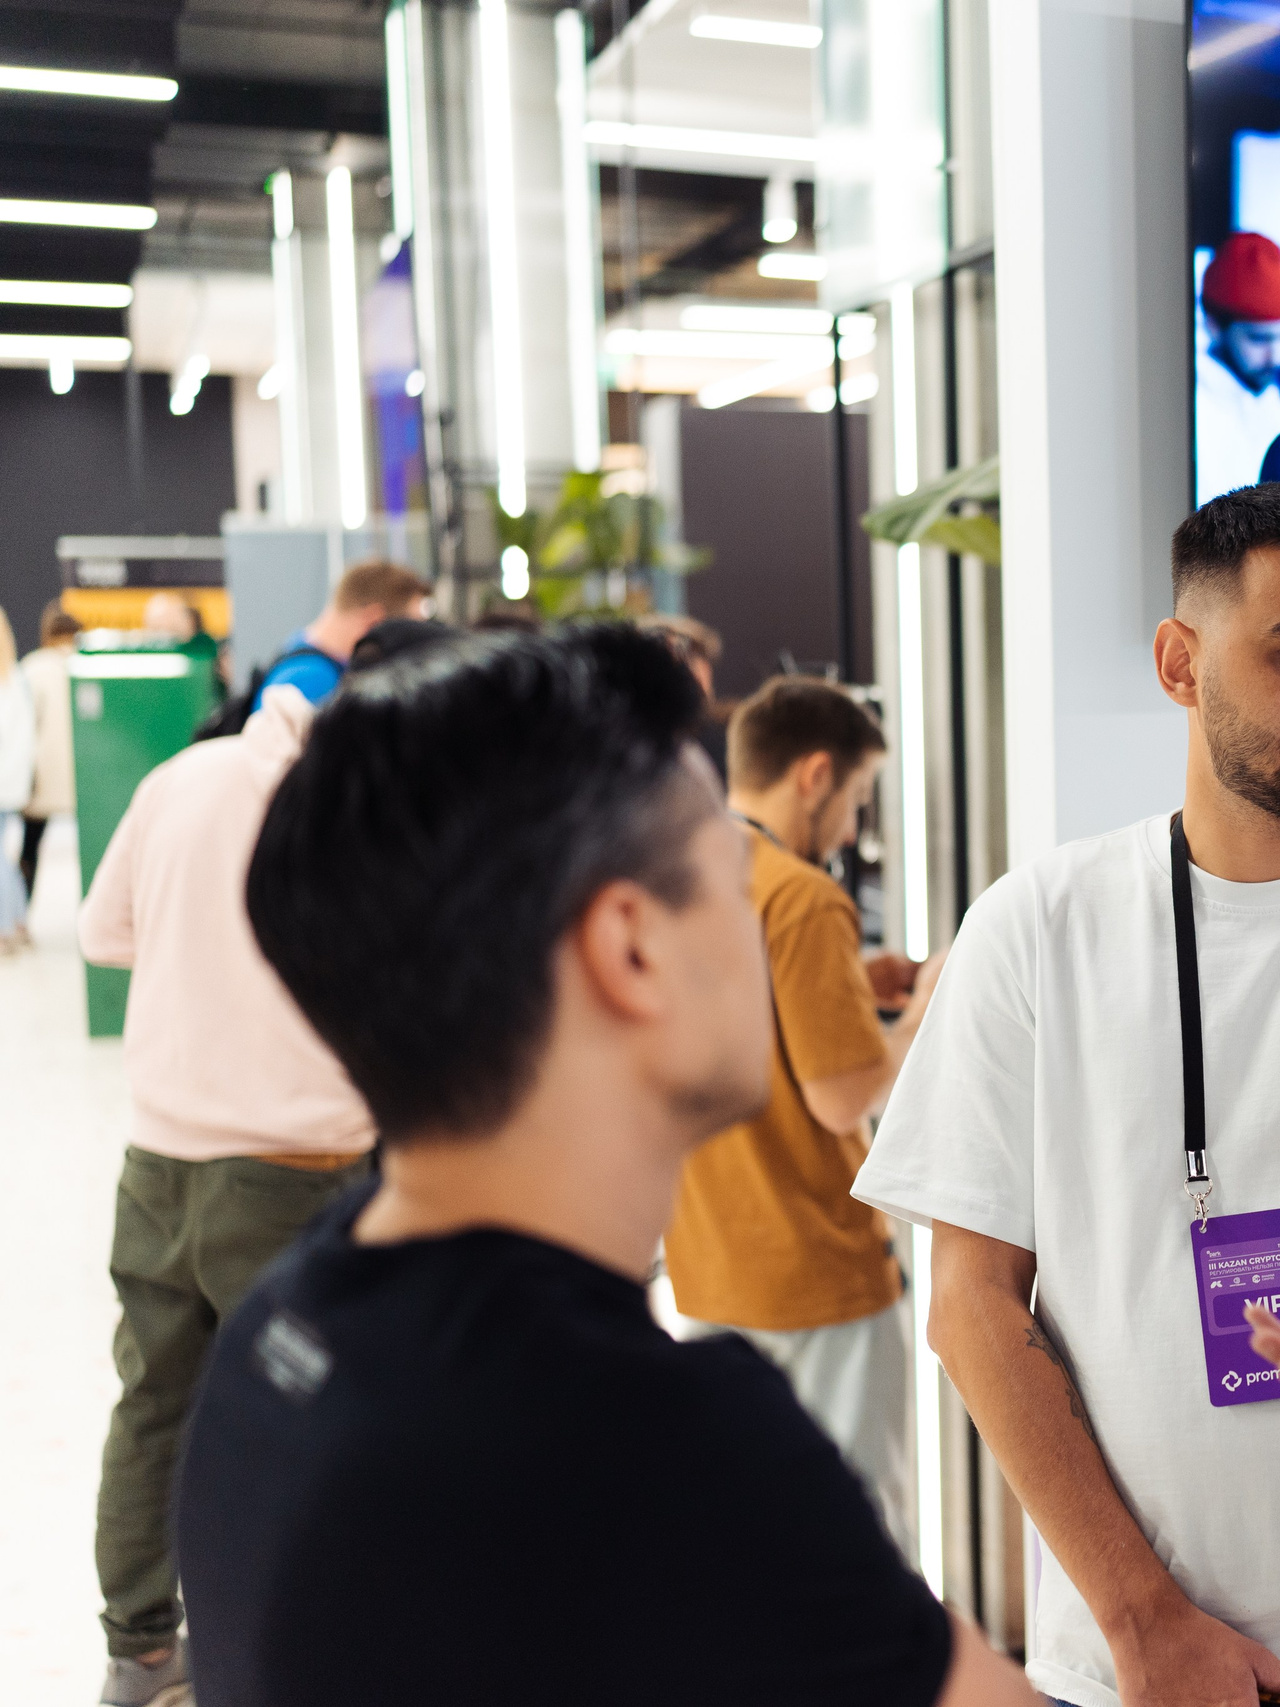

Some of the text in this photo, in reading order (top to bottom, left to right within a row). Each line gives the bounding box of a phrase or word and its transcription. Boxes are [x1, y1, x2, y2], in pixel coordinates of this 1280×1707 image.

[1209, 1266, 1251, 1276] РЕГУЛИРОВАТЬ
[1252, 1262, 1274, 1271] НЕЛЬЗЯ
[1218, 1259, 1247, 1269] KAZAN
